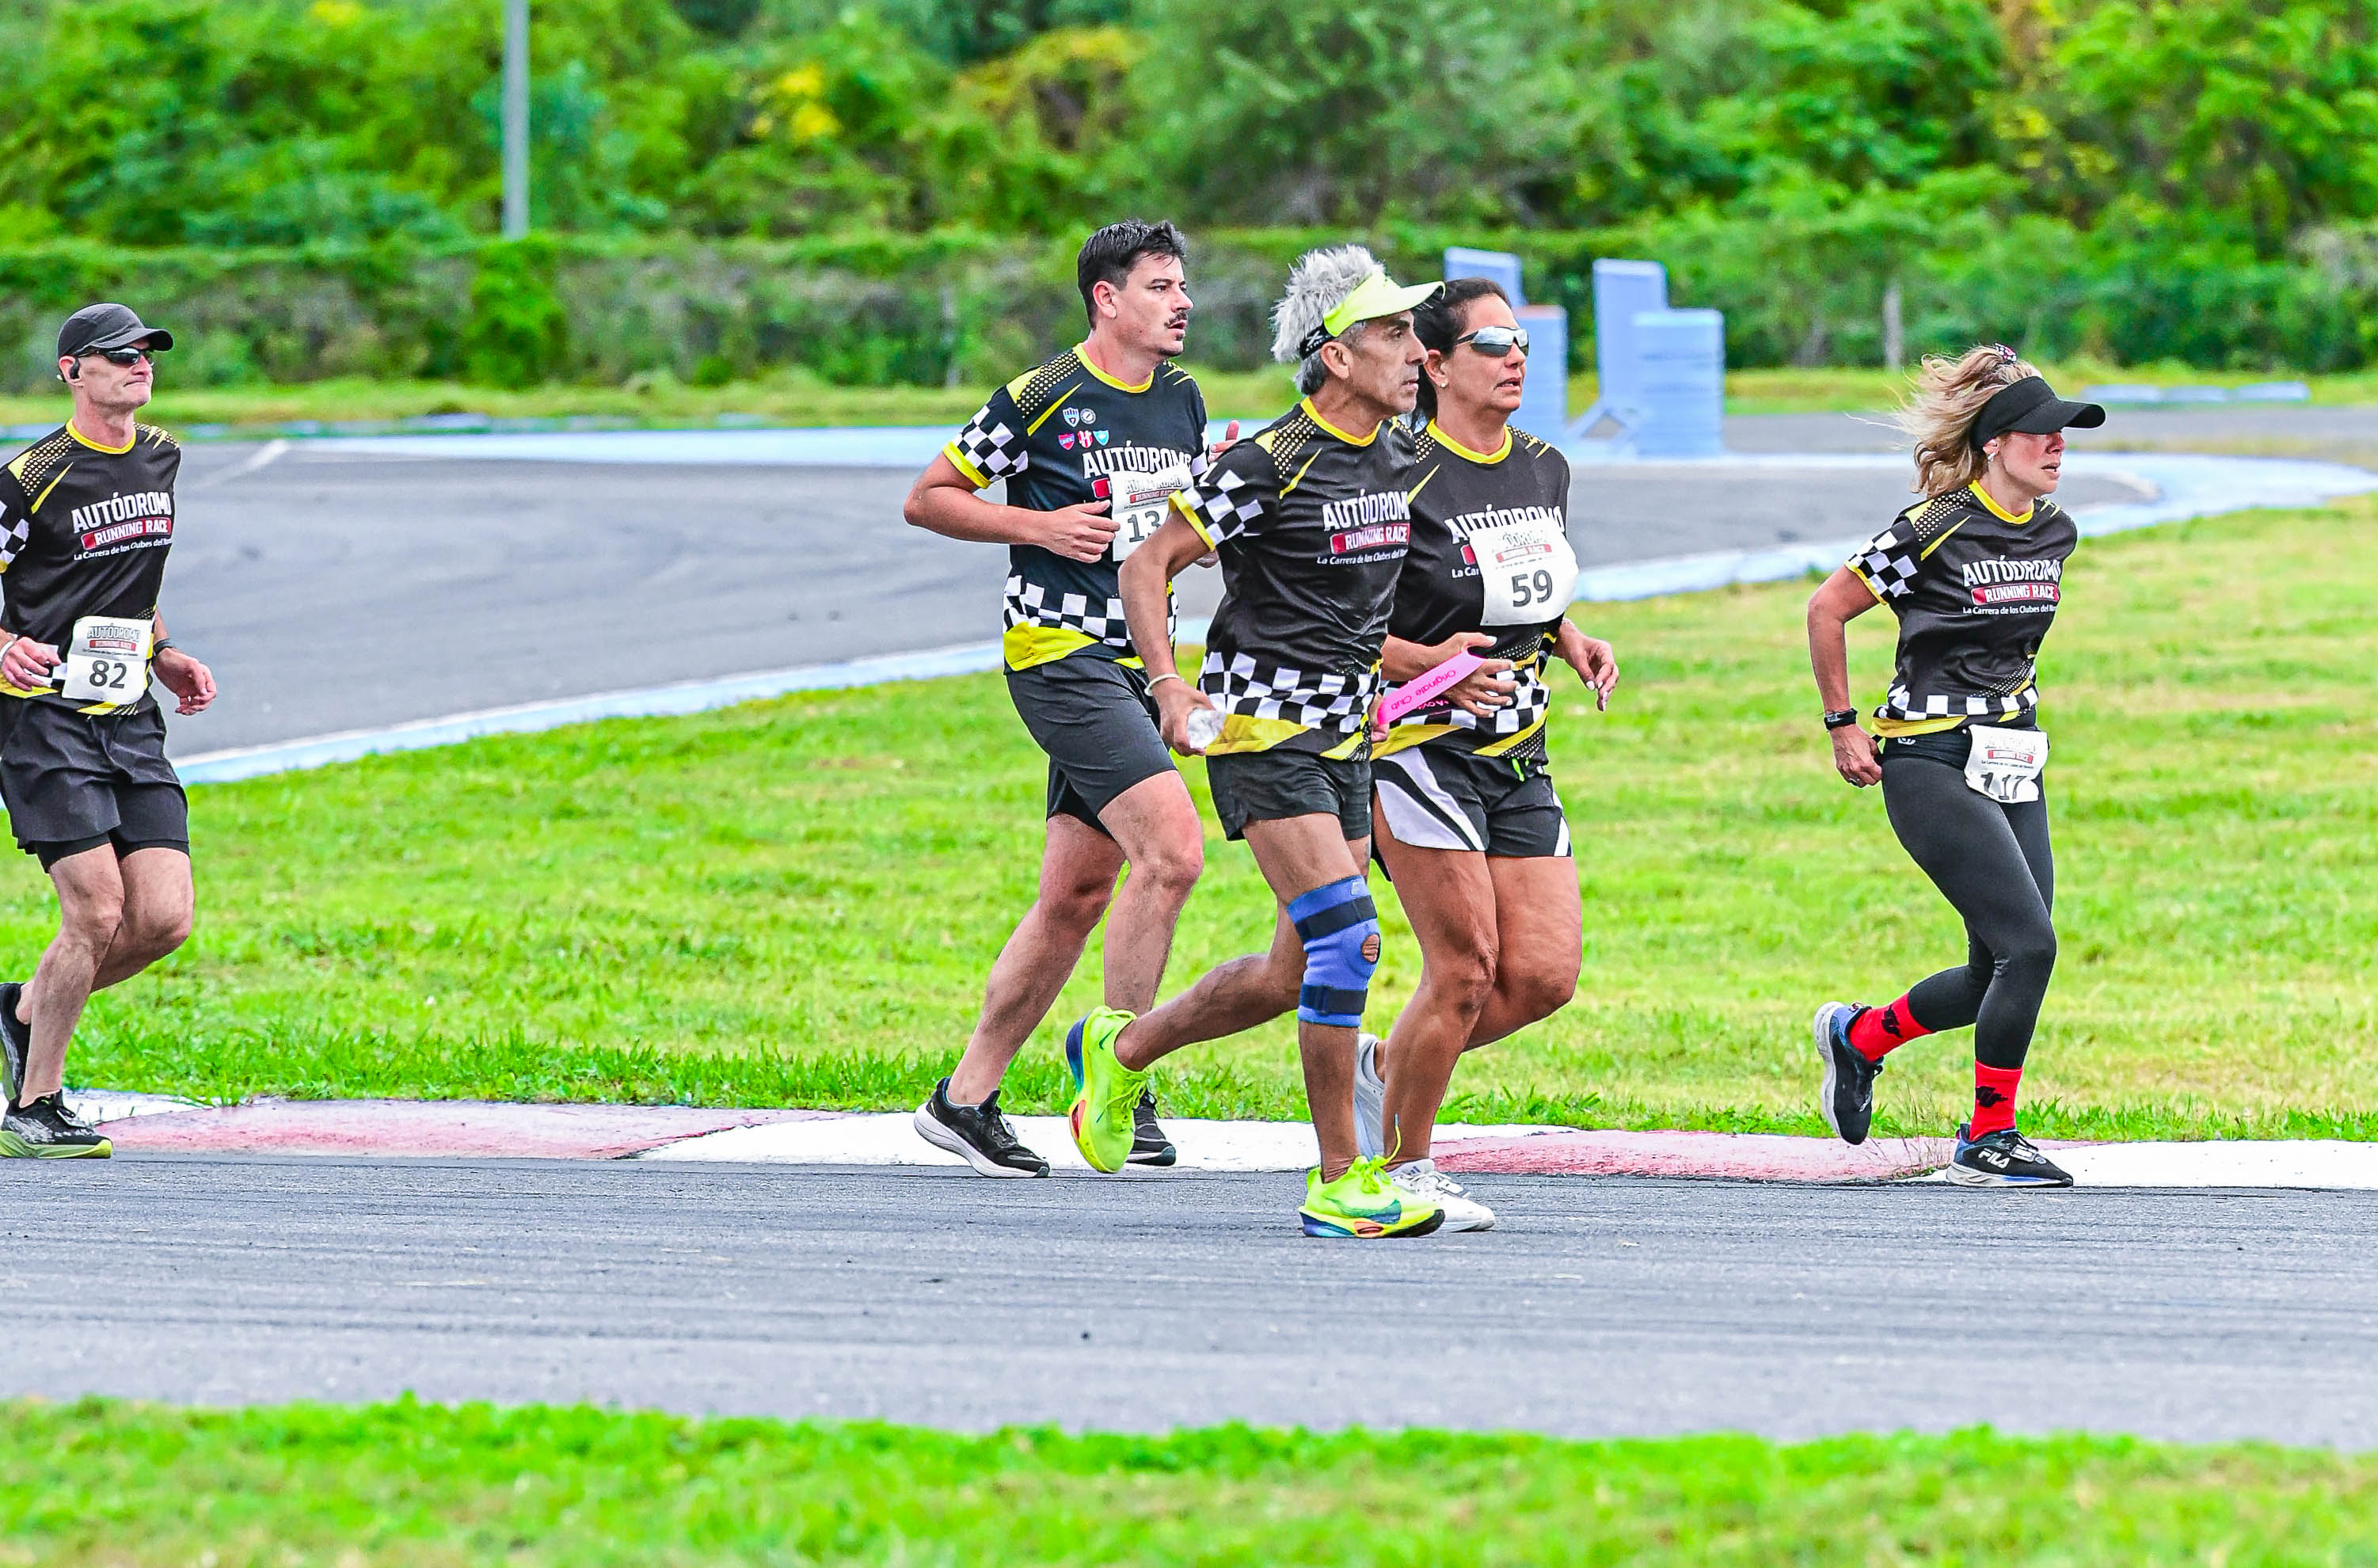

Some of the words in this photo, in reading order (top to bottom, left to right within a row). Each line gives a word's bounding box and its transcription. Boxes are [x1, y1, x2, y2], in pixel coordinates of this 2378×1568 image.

[1322, 489, 1410, 531] AUTÓDROM
[94, 521, 143, 545] RUNNING
[1345, 527, 1384, 550] RUNNING
[1386, 526, 1407, 542] RACE
[83, 550, 109, 559] Carrera
[1452, 569, 1463, 578] La
[1961, 554, 2060, 587] AUTÓDROM
[1511, 570, 1553, 607] 59
[1984, 585, 2030, 602] RUNNING
[2031, 584, 2054, 599] RACE
[89, 660, 127, 689] 82
[1391, 695, 1412, 710] Club
[1980, 772, 2027, 800] 117
[1978, 1147, 2011, 1169] FILA
